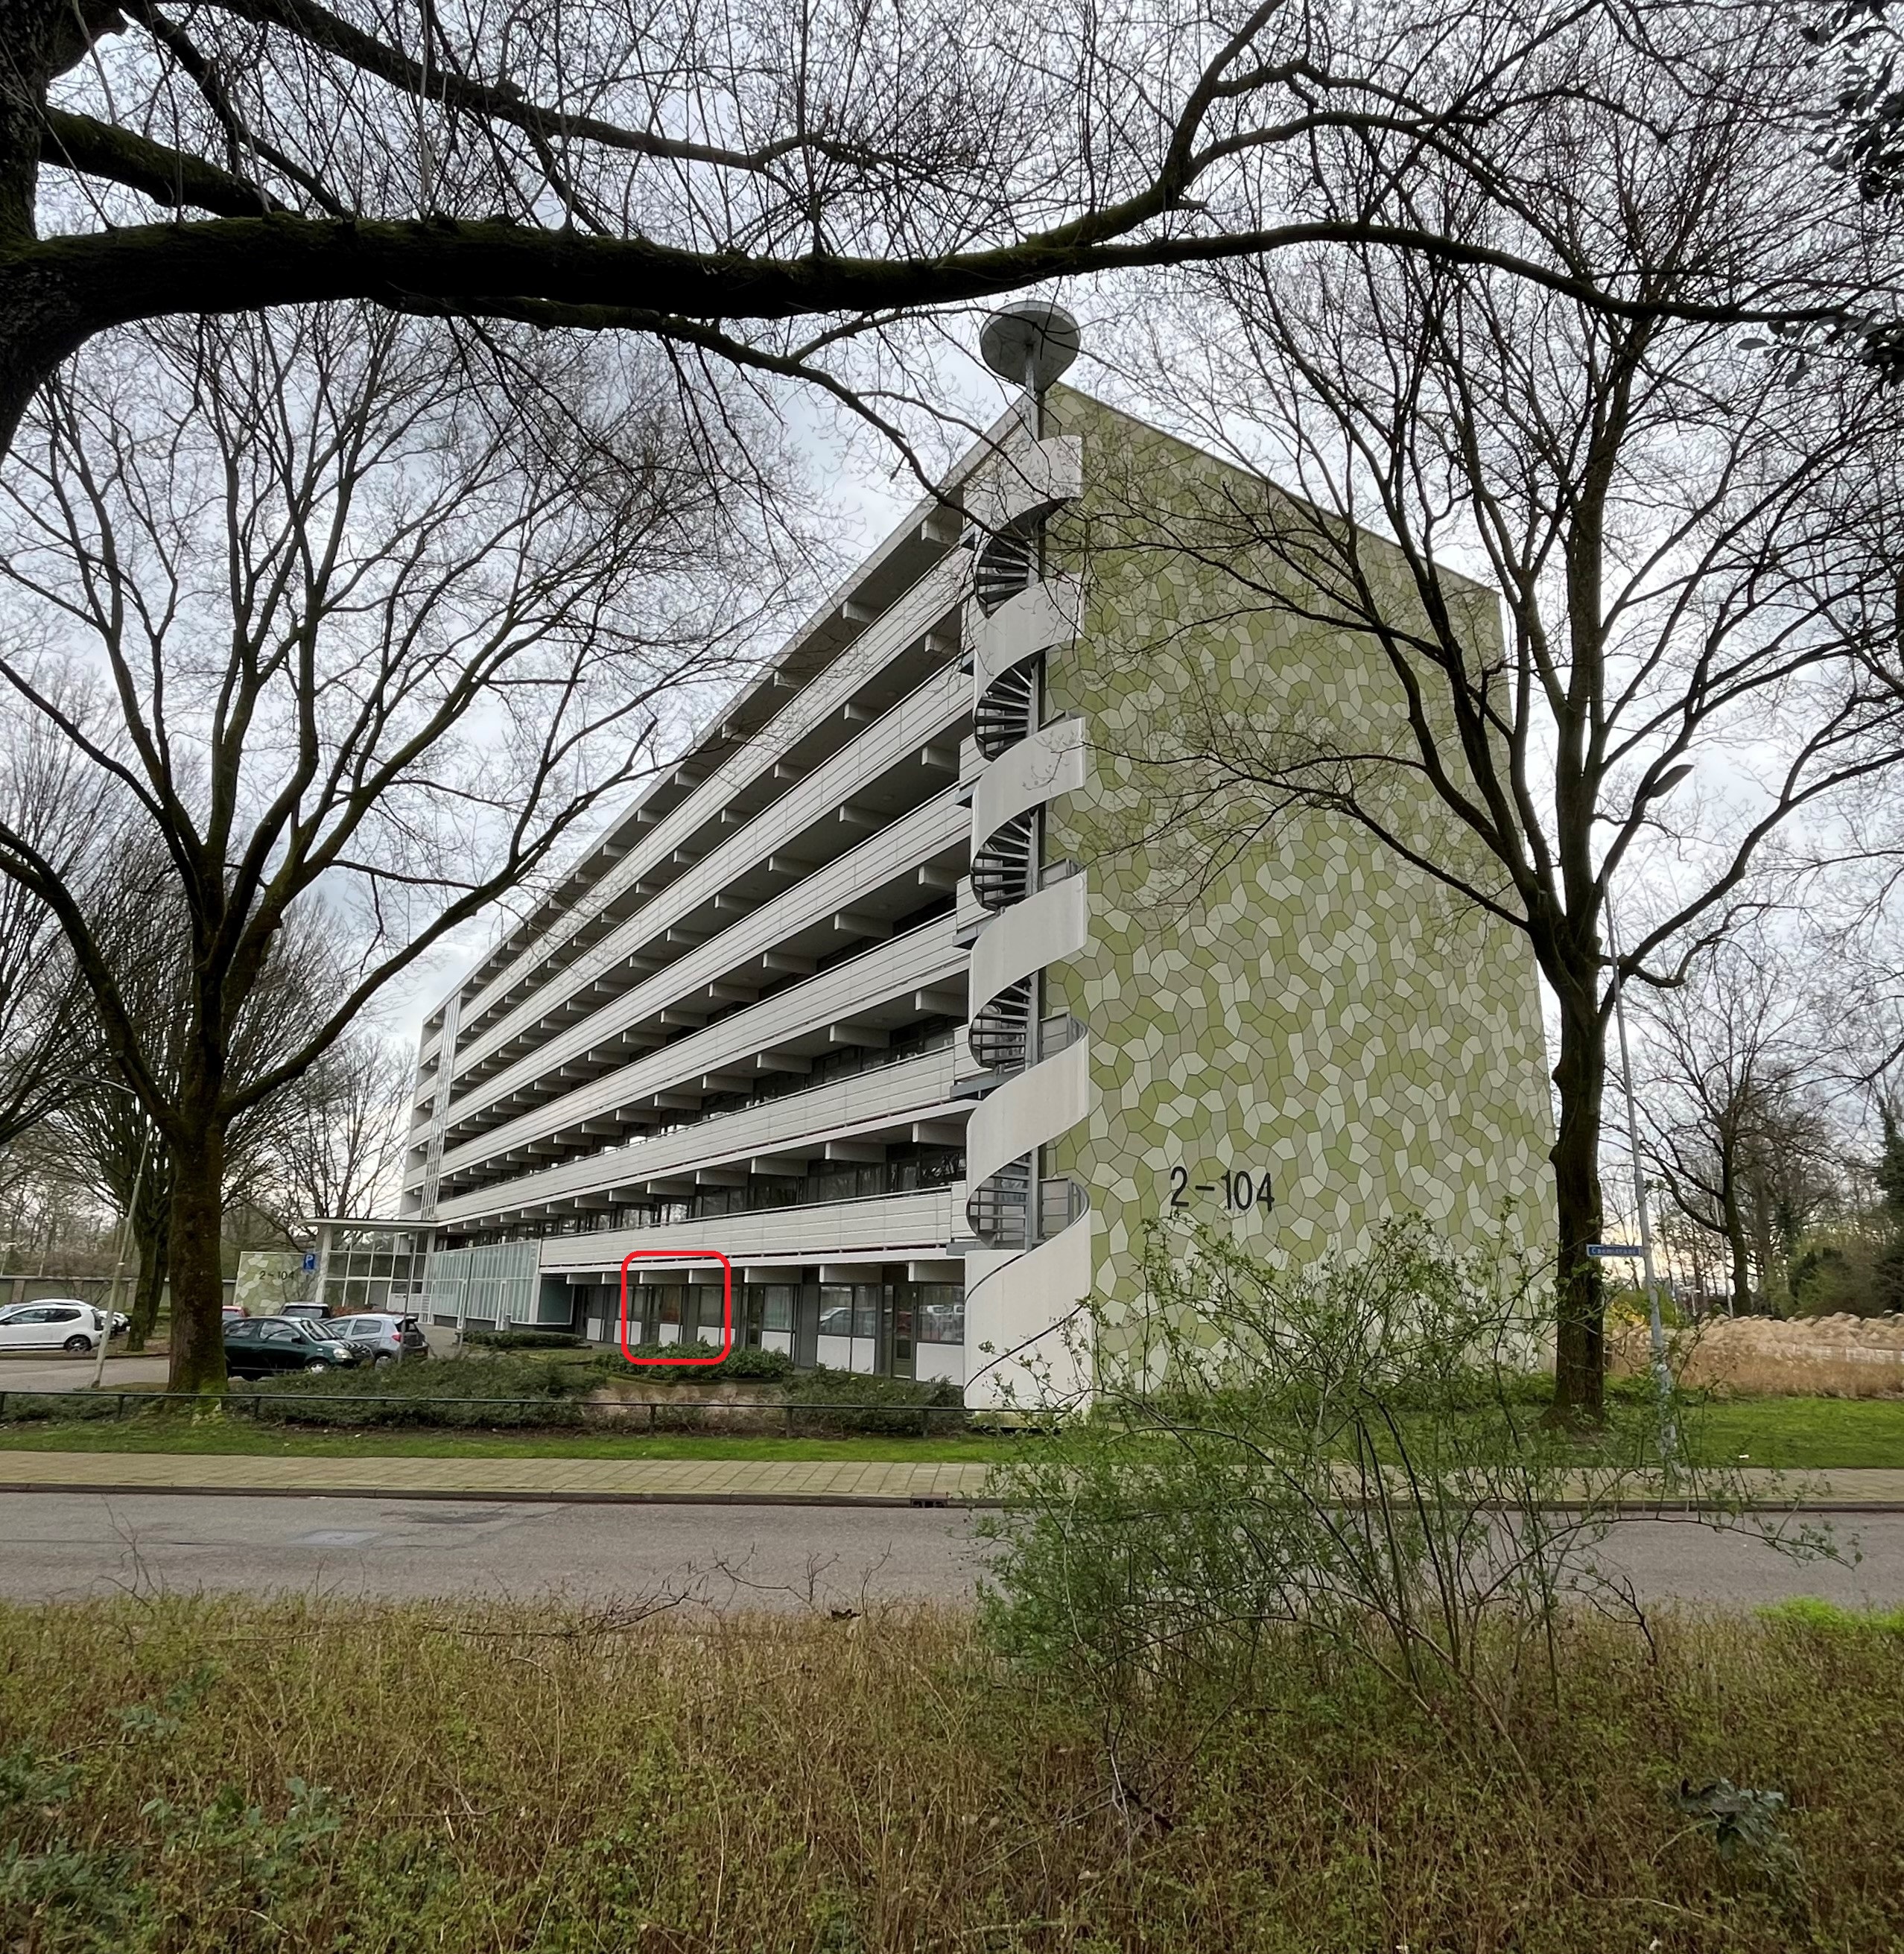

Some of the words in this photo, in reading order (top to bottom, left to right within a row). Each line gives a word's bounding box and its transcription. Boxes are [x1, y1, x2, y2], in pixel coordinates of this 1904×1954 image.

[1170, 1166, 1275, 1212] 2-104
[305, 1254, 314, 1269] P
[259, 1270, 295, 1280] 2-104
